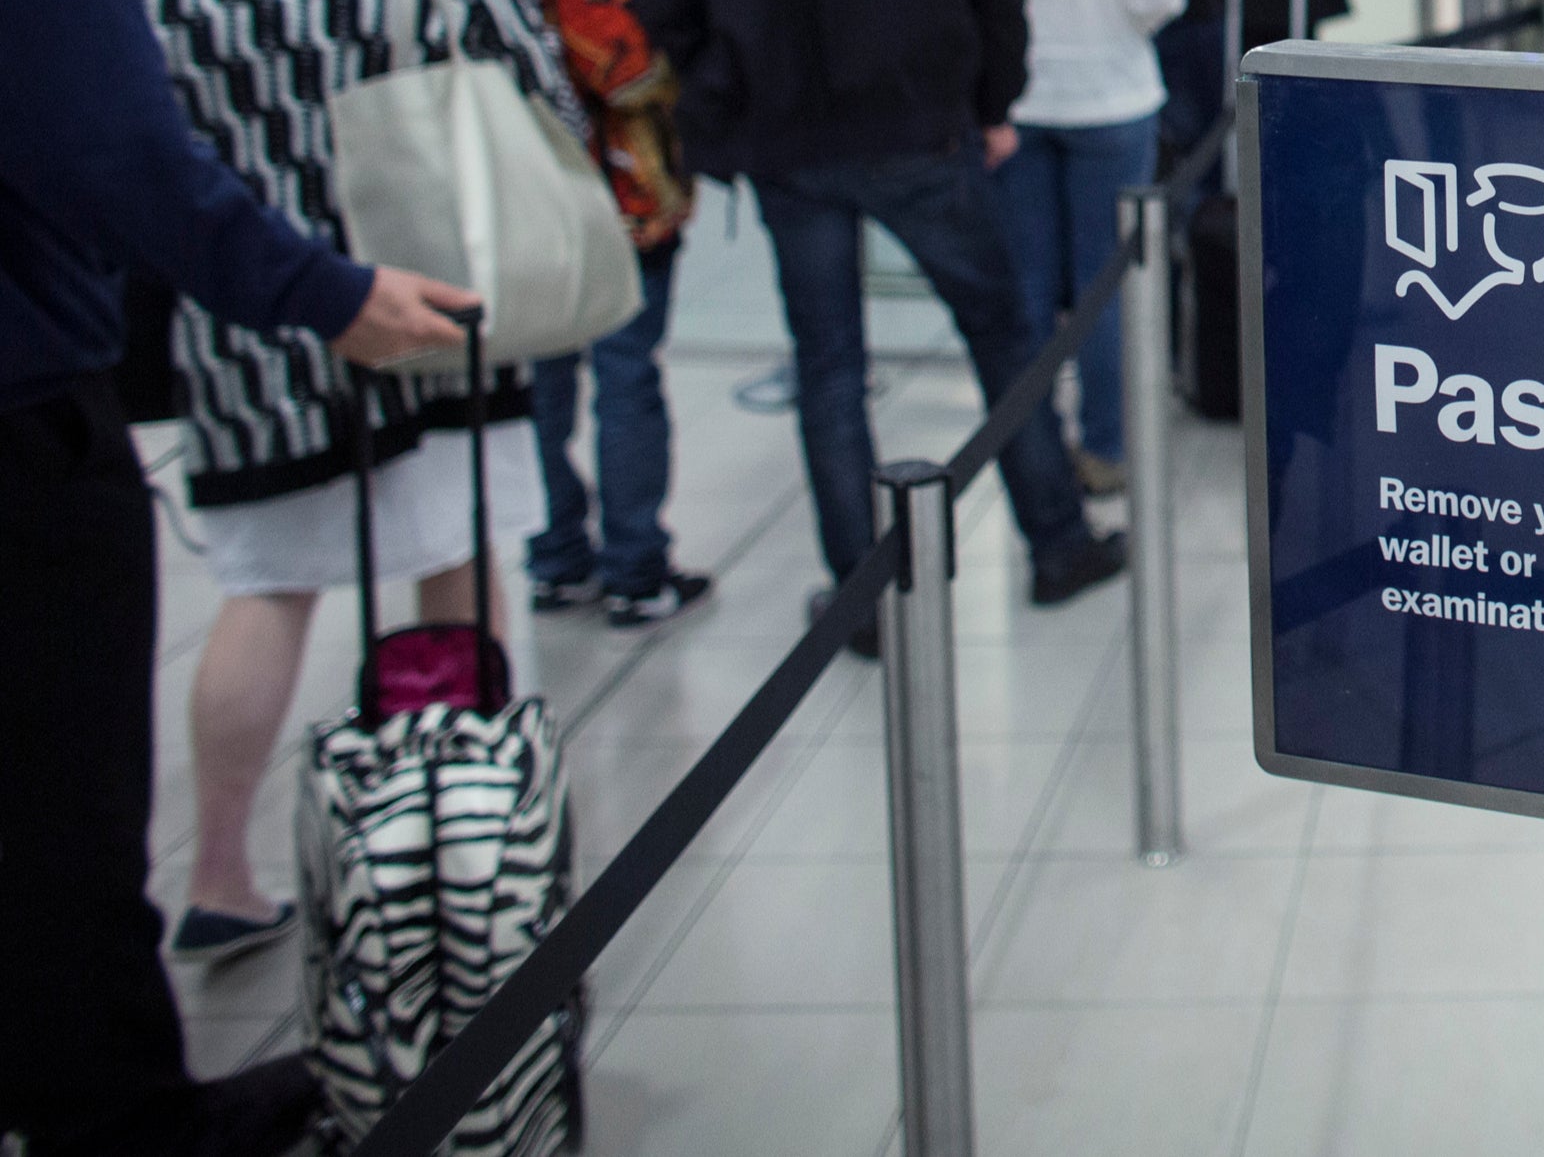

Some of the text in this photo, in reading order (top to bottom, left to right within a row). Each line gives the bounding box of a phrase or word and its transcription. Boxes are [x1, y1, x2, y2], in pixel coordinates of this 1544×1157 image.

[1380, 477, 1522, 525] Remove
[1378, 534, 1489, 574] wallet
[1500, 551, 1537, 578] or
